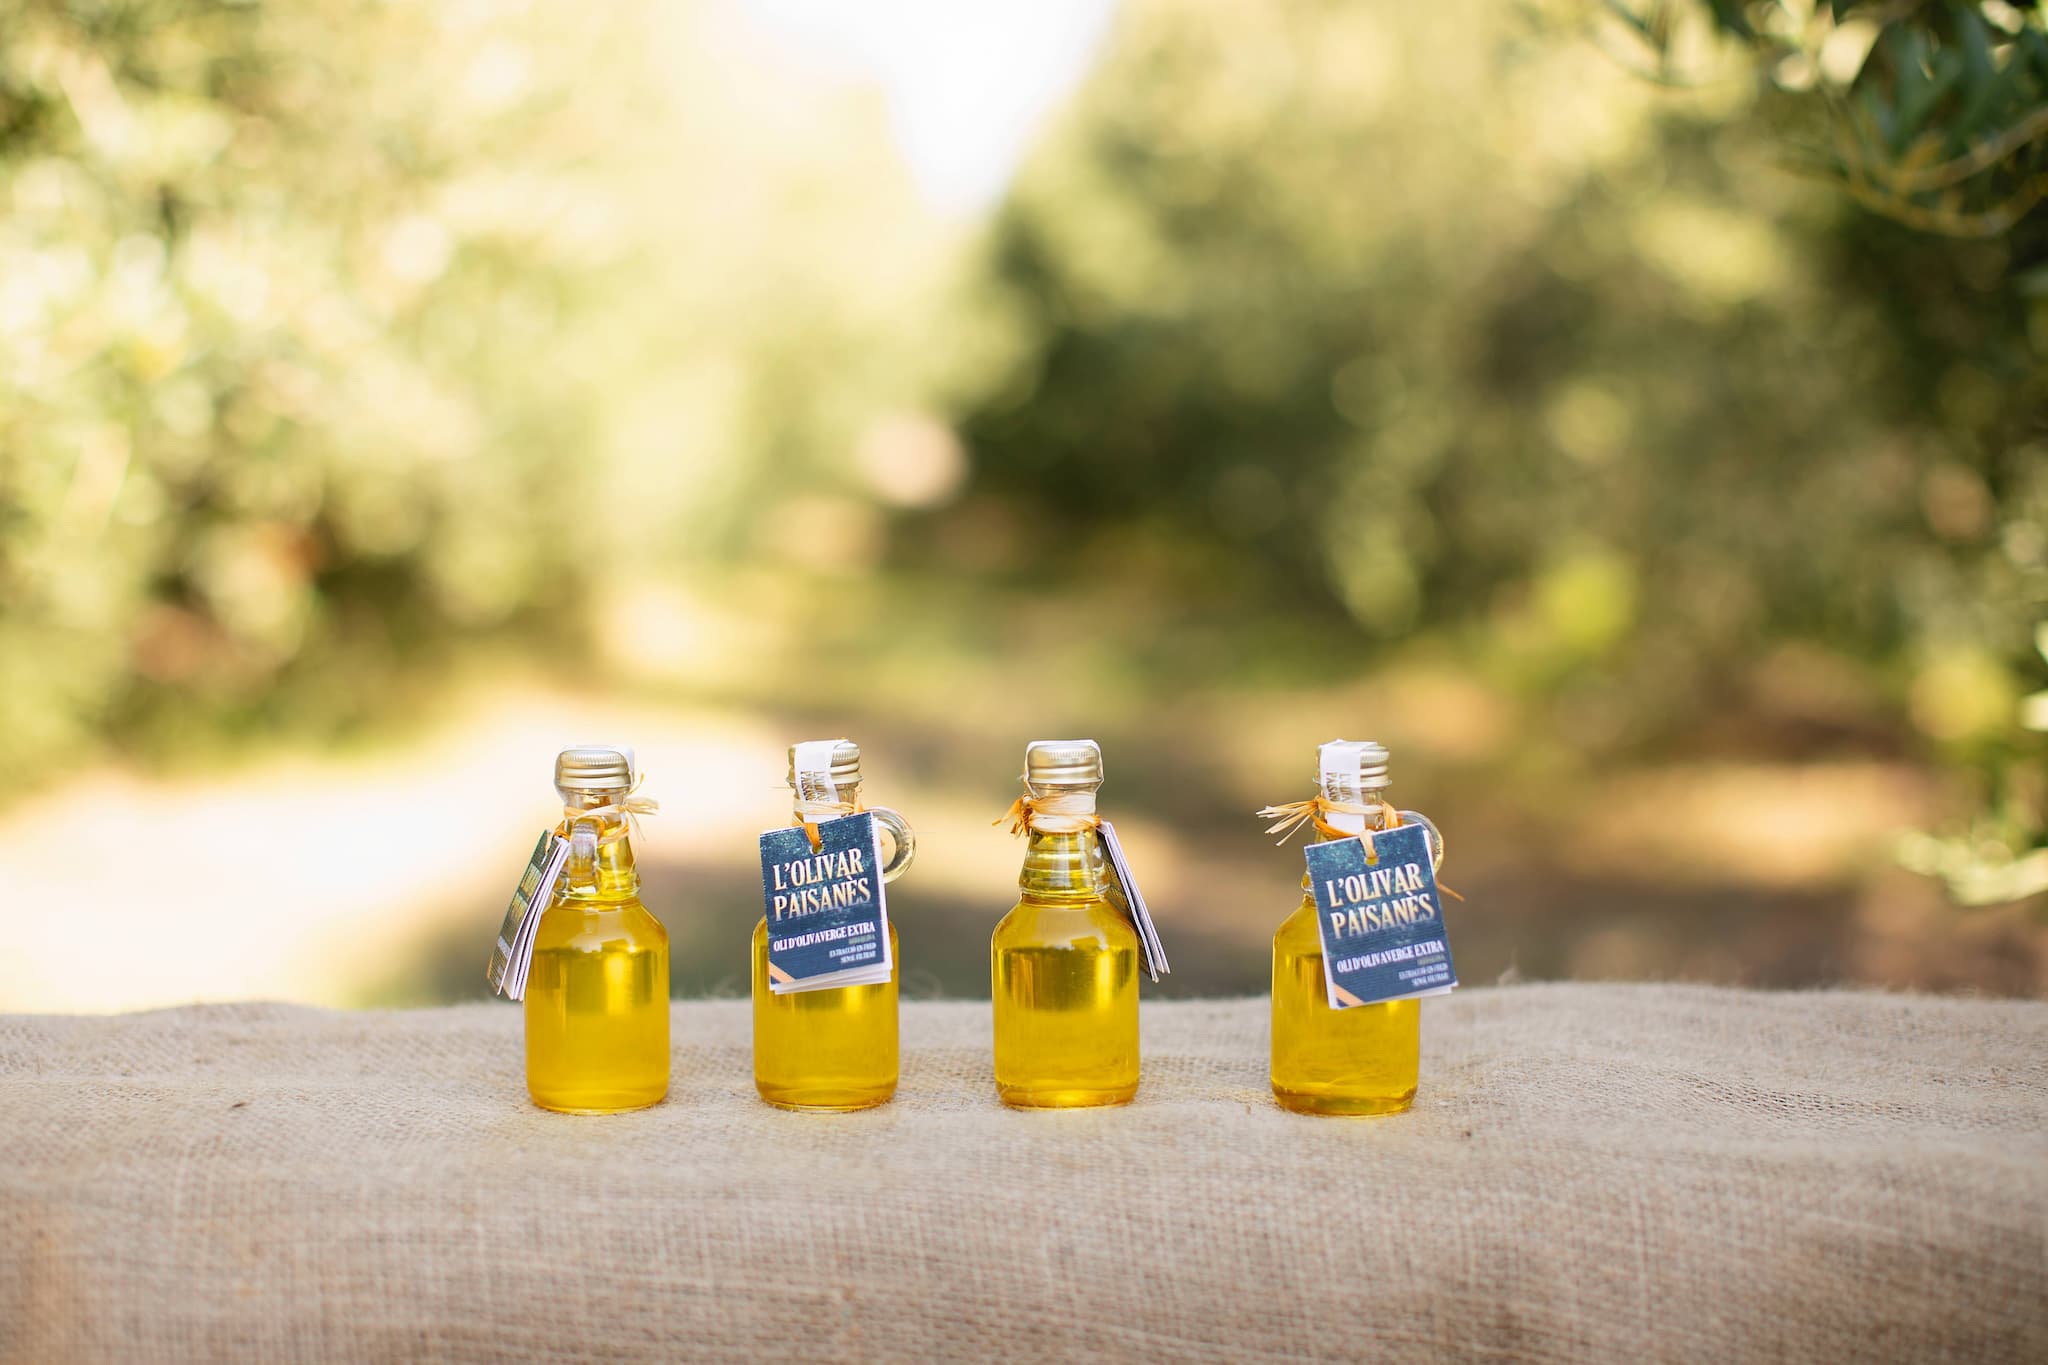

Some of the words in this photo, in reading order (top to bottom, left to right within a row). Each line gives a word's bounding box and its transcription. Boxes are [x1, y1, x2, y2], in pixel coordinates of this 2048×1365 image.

[773, 848, 864, 891] L'OLIVAR
[1326, 863, 1424, 908] L'OLIVAR
[774, 876, 871, 922] PAISANÈS
[1330, 890, 1435, 939] PAISANÈS
[773, 939, 788, 952] OLI
[848, 921, 875, 937] EXTRA
[1336, 958, 1352, 973] OLI
[1415, 939, 1445, 957] EXTRA
